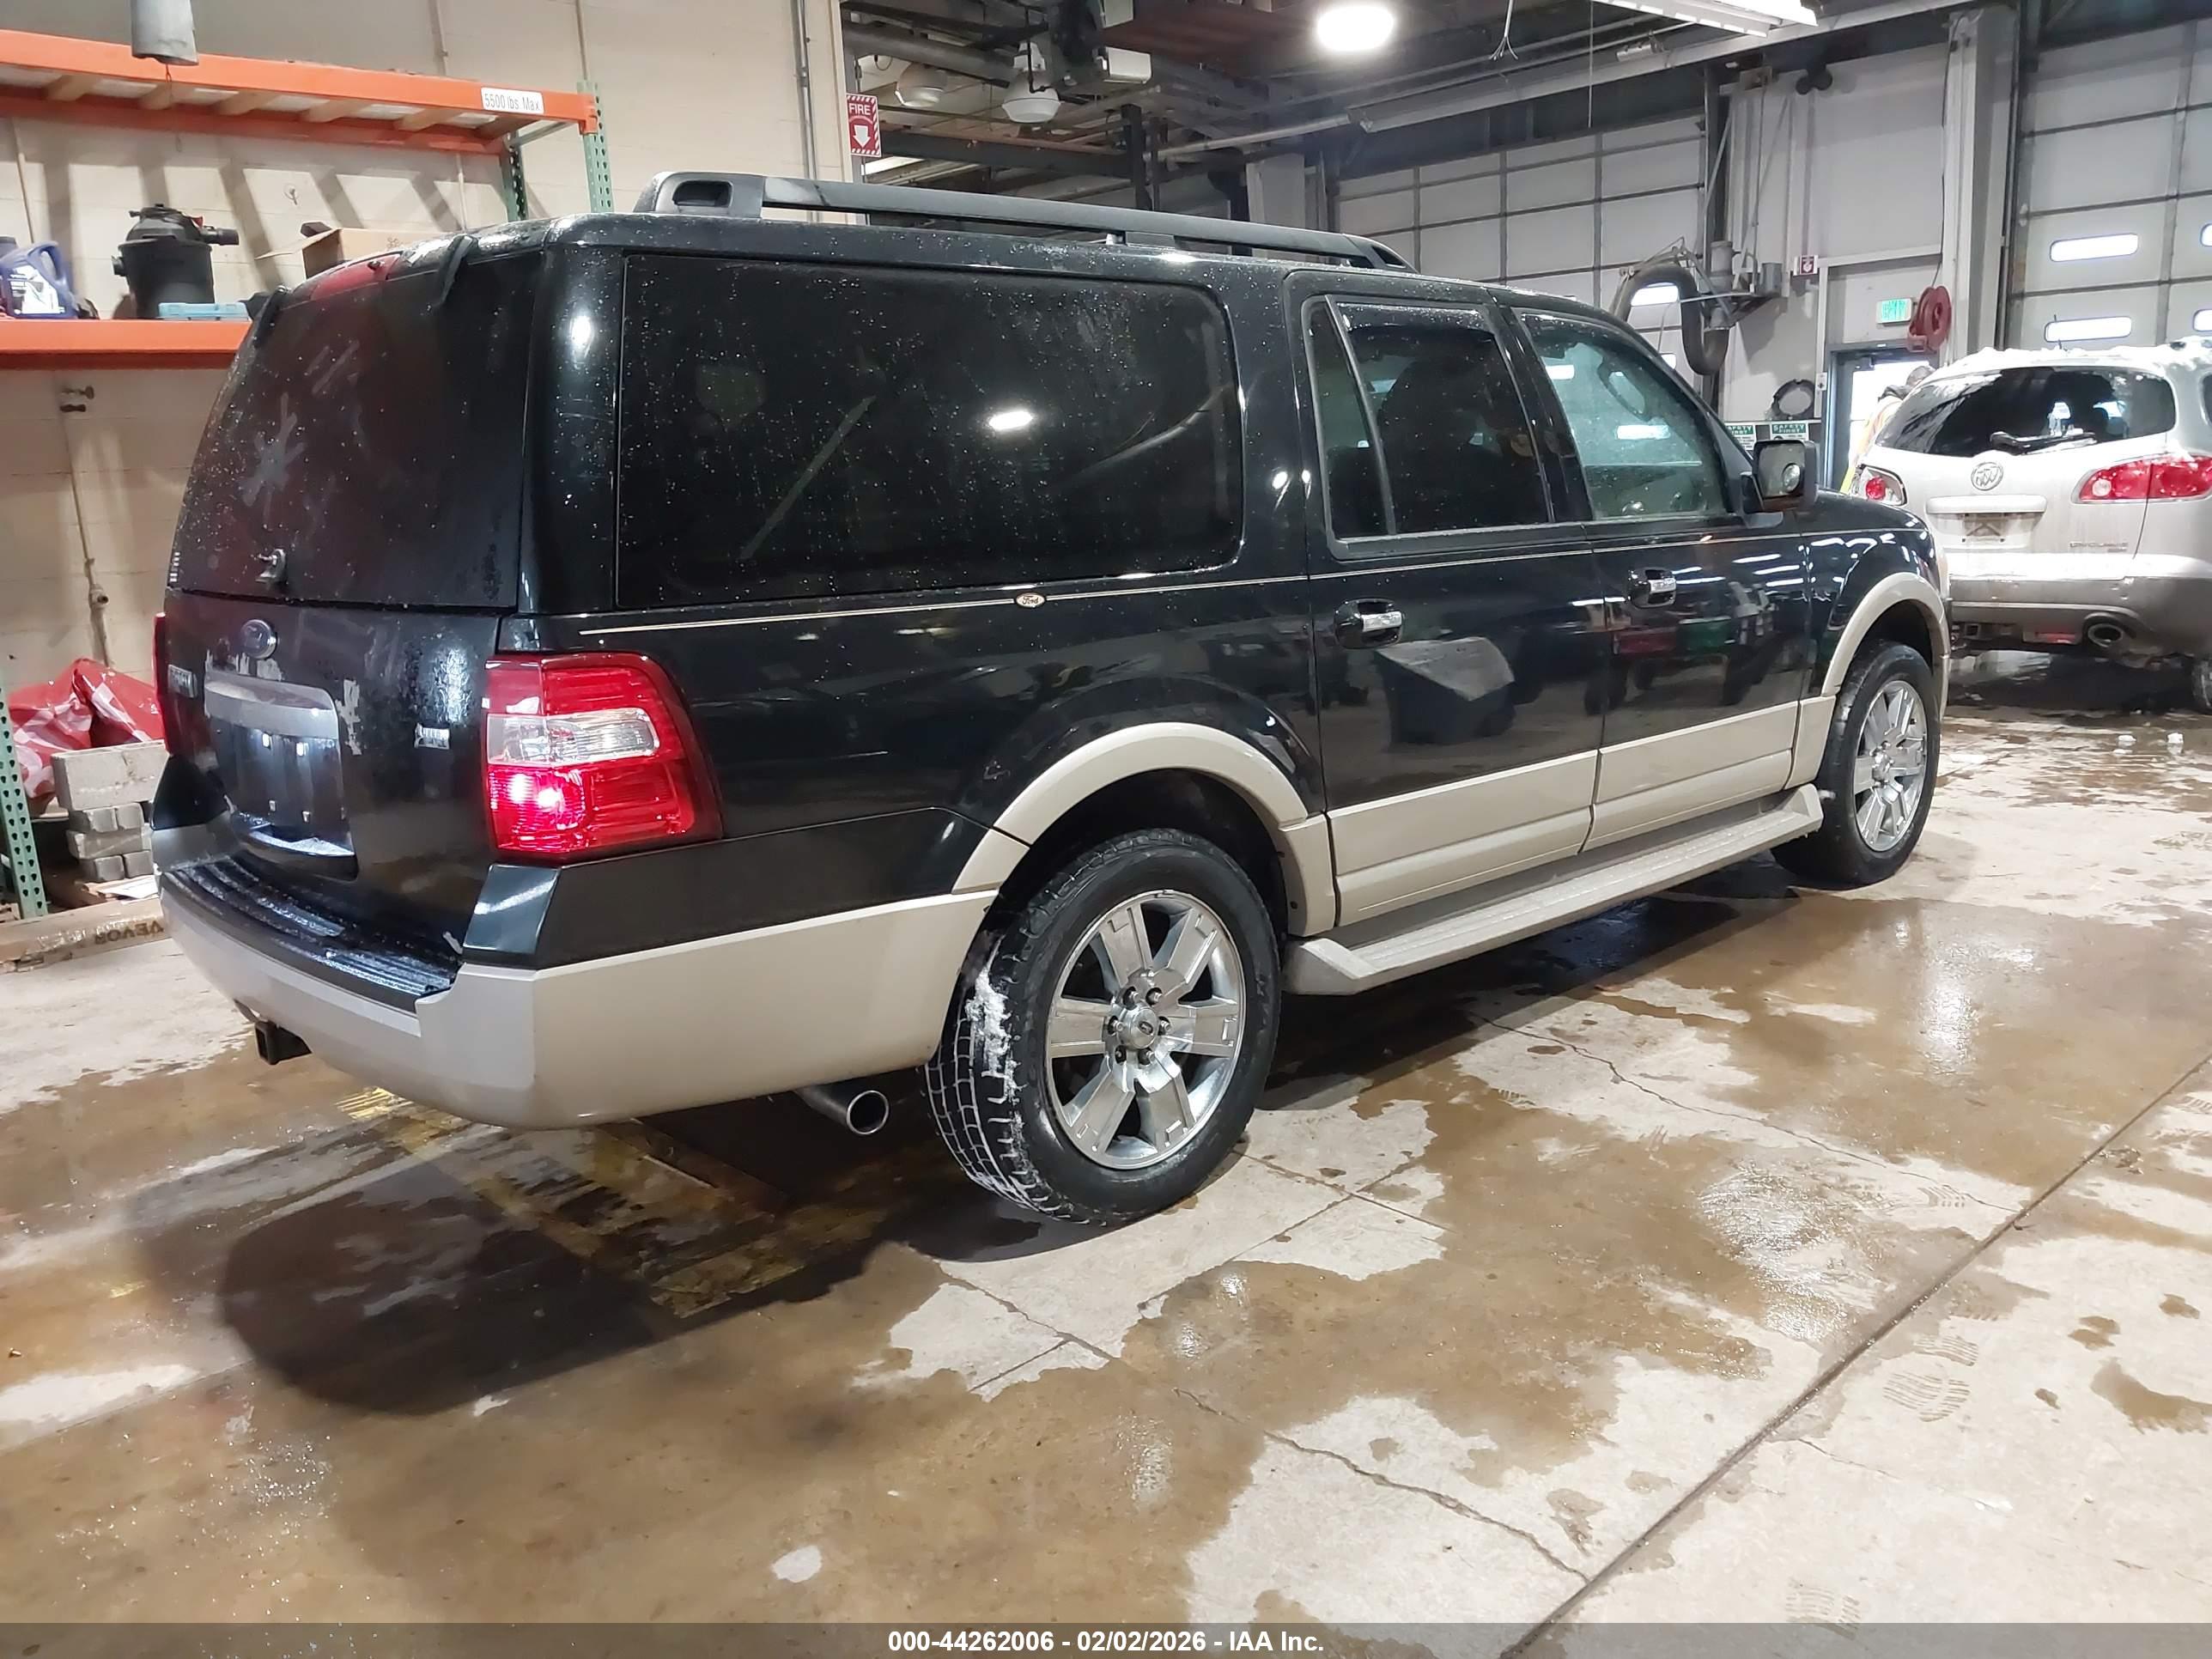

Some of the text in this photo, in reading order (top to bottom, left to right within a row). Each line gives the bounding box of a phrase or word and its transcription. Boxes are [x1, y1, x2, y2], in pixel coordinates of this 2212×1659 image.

[484, 93, 541, 111] 5500 lbs Max
[848, 102, 872, 116] FIRE
[94, 919, 165, 945] VEVOR
